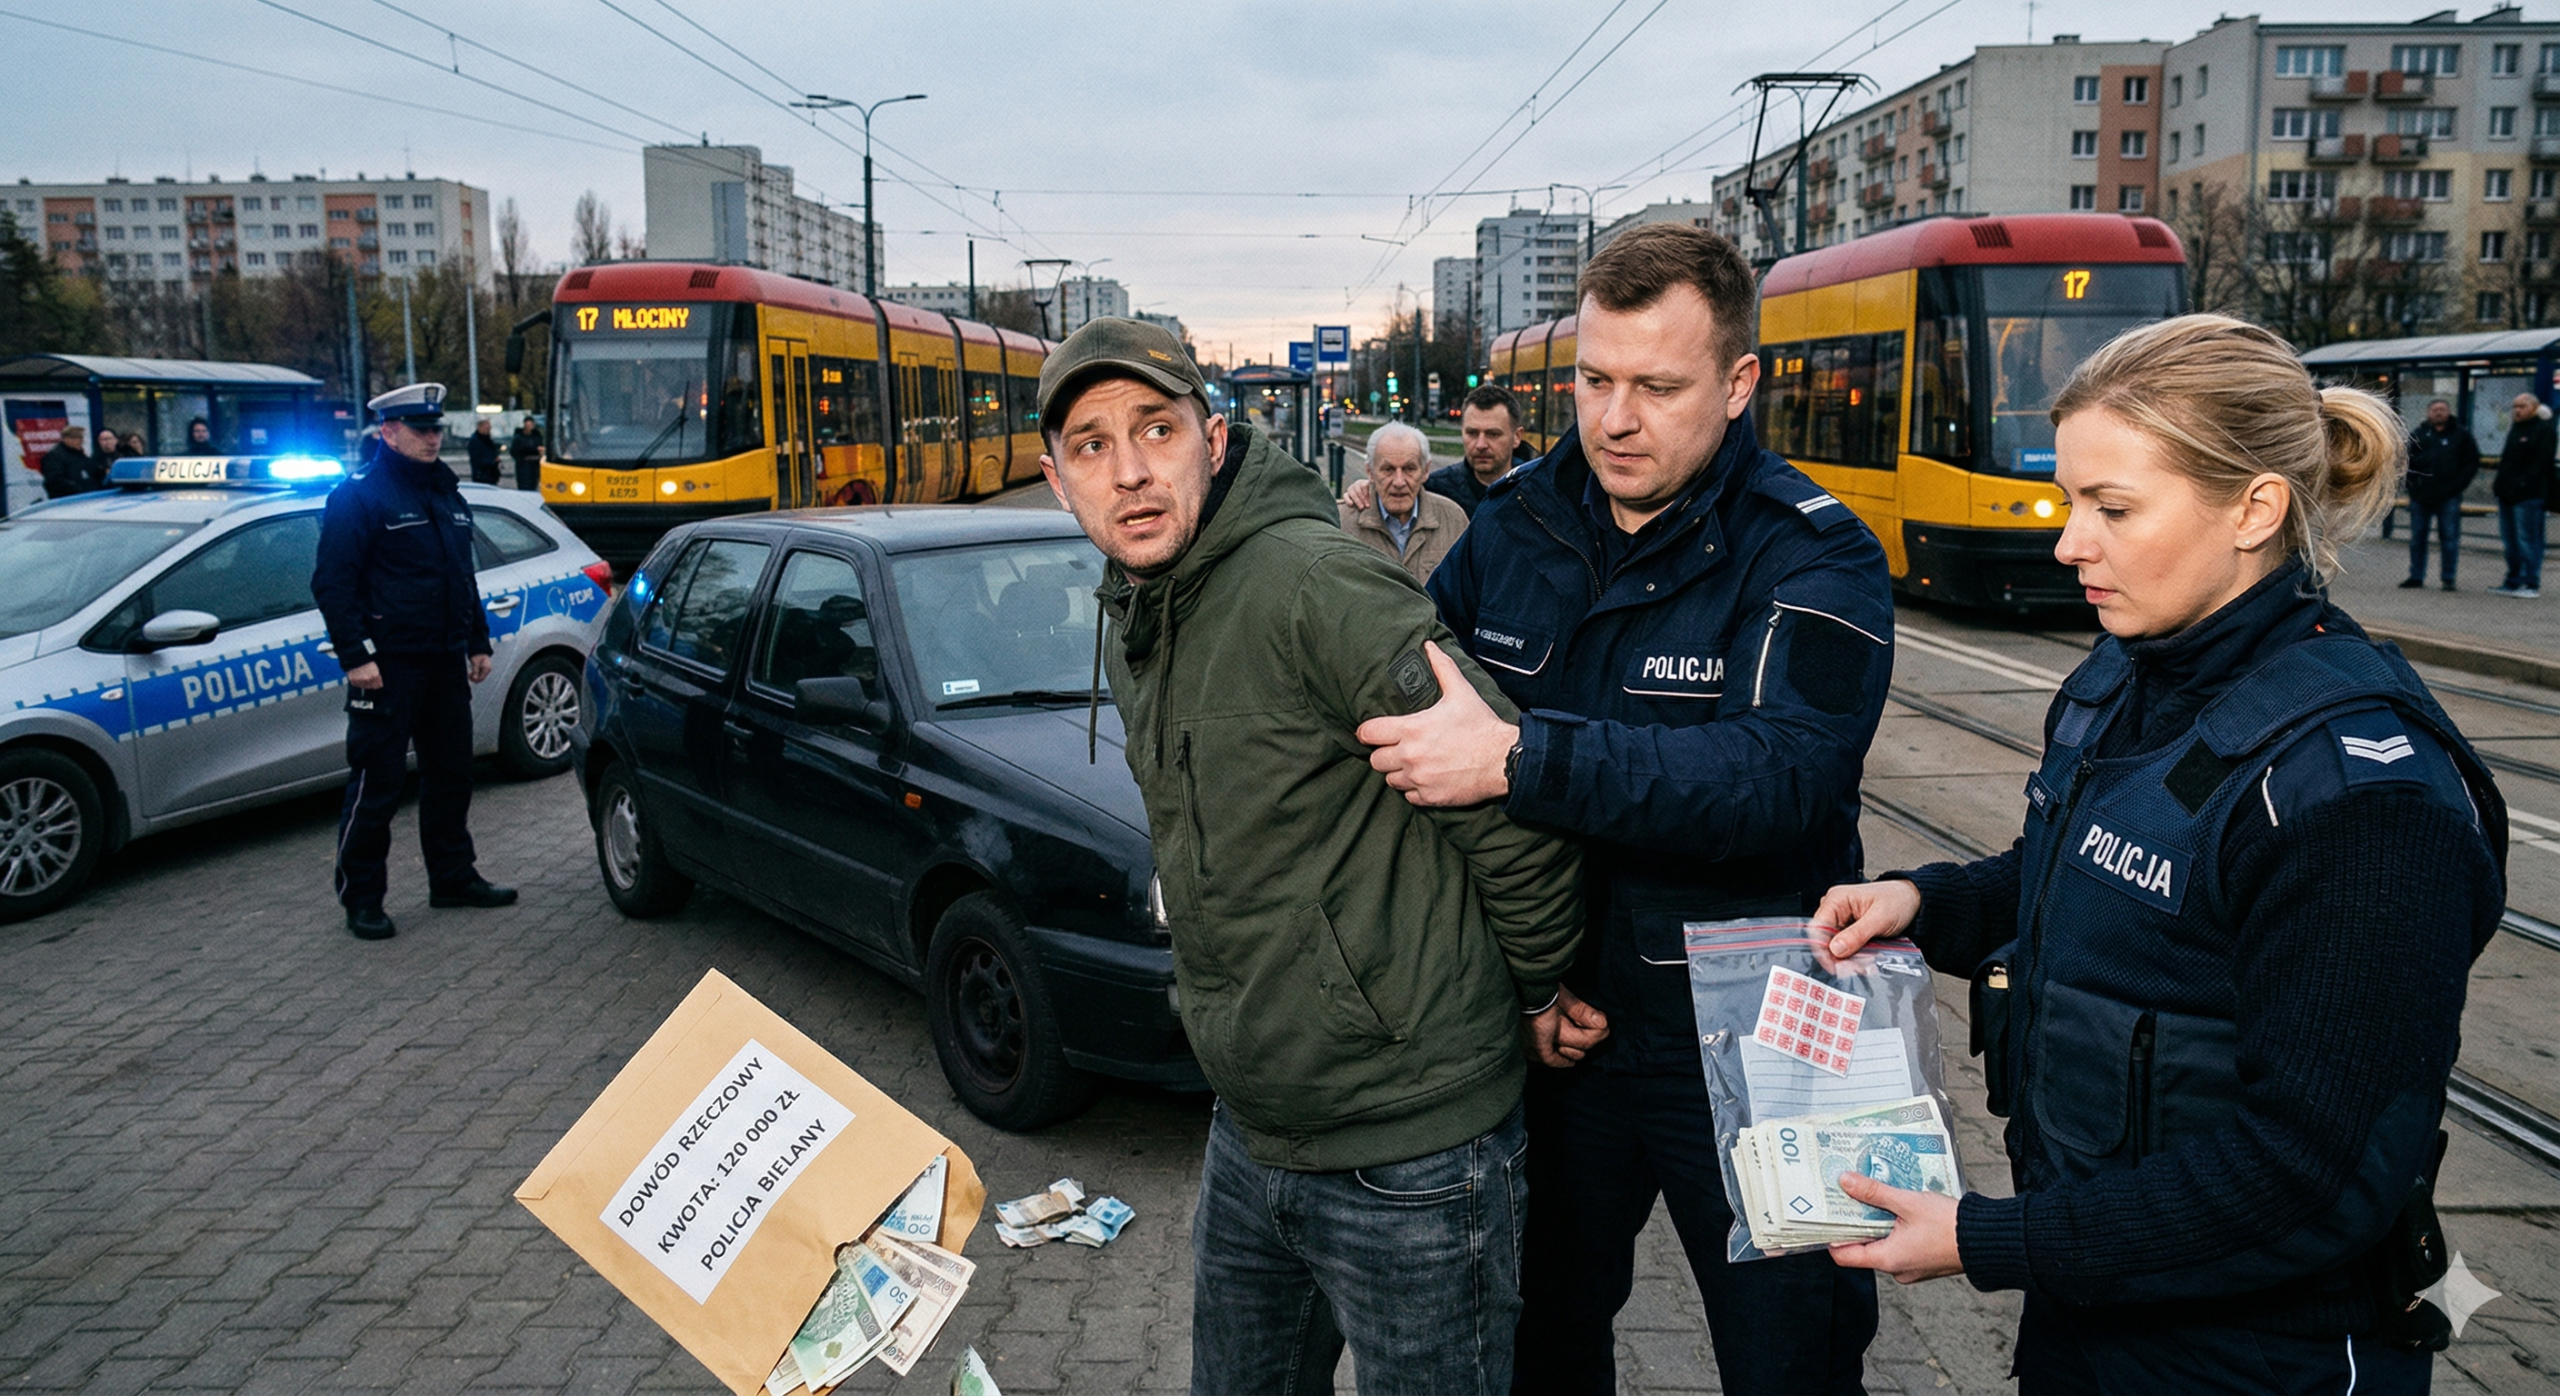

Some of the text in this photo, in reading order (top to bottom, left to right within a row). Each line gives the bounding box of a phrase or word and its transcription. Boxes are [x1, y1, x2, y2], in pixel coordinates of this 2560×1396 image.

[2064, 271, 2090, 299] 17
[576, 307, 689, 331] 17 MŁOCINY
[158, 461, 221, 478] POLICJA
[182, 651, 314, 709] POLICJA
[1643, 656, 1724, 682] POLICJA
[2079, 824, 2171, 898] POLICJA
[619, 1057, 763, 1227] DOWÓD RZECZOWY
[1780, 1127, 1801, 1166] 100
[658, 1089, 800, 1254] KWOTA: 120 000 ZŁ
[701, 1118, 826, 1271] POLICJA BIELANY
